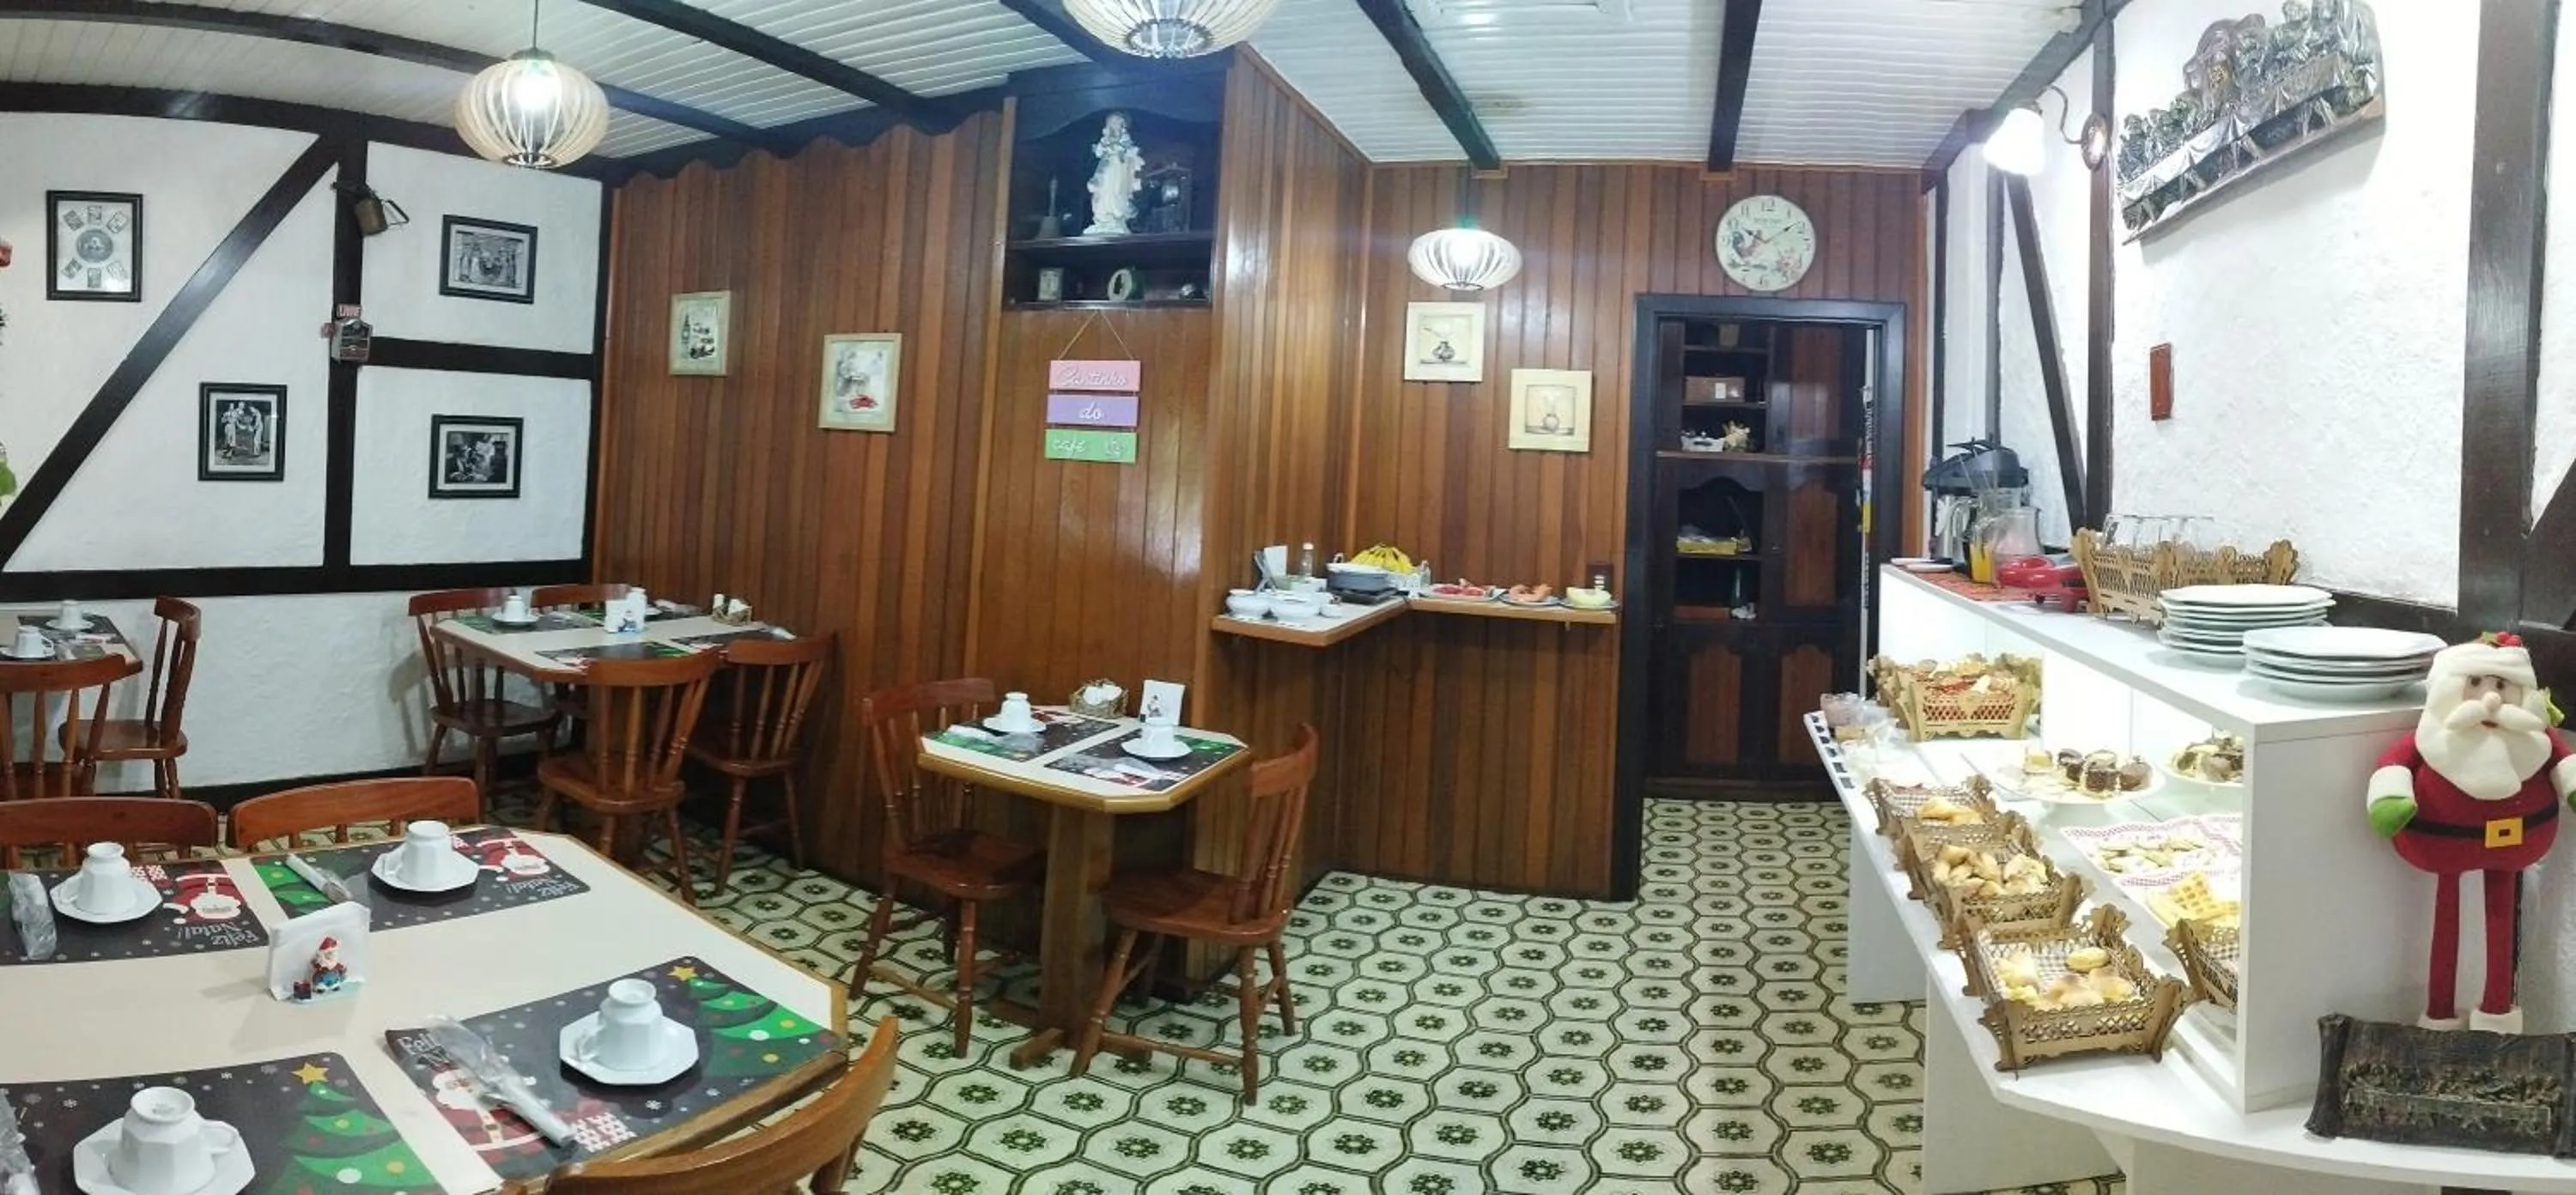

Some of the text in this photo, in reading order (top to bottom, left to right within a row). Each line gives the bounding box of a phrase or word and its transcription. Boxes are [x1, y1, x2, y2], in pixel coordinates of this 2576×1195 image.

[1079, 401, 1104, 420] do
[210, 929, 259, 946] Feliz
[398, 1032, 439, 1055] Feli
